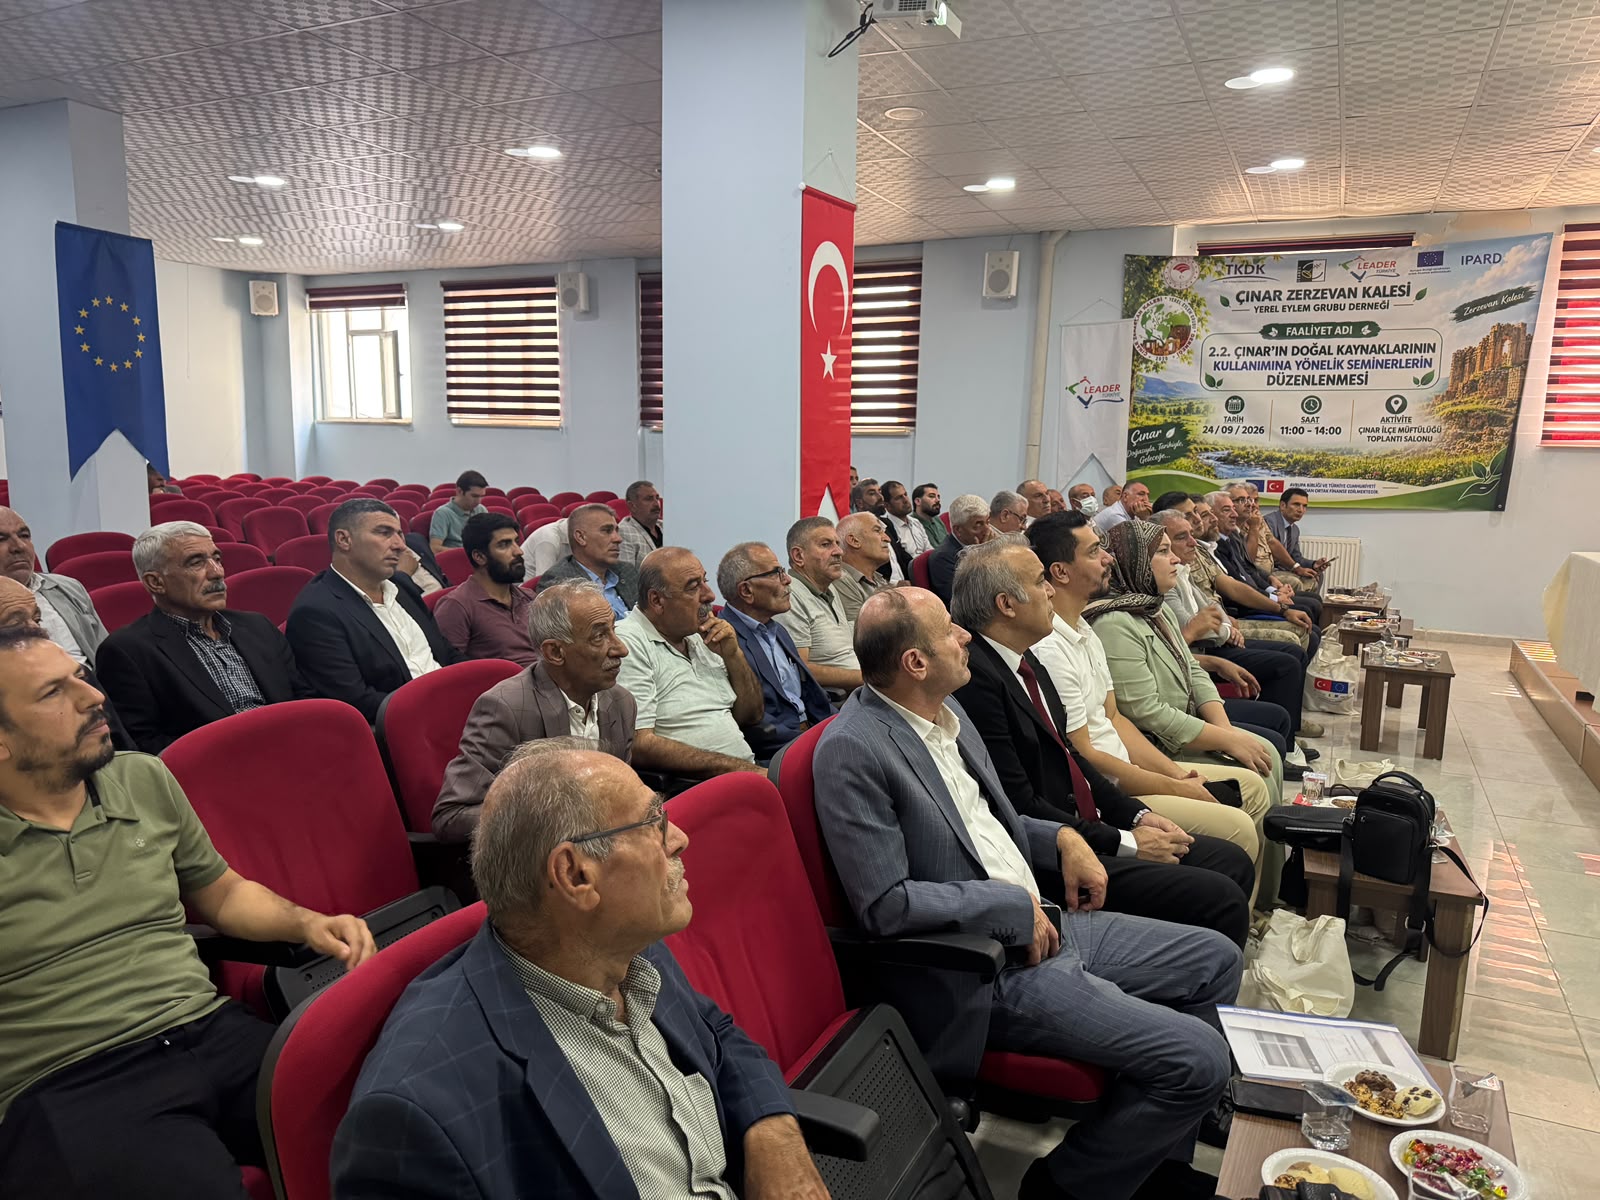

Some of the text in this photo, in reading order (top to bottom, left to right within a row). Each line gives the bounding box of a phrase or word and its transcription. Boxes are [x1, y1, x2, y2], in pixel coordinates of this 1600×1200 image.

[1461, 253, 1502, 265] IPARD
[1225, 264, 1266, 275] TKDK
[1357, 261, 1397, 270] LEADER
[1235, 282, 1411, 305] ÇINAR ZERZEVAN KALESİ
[1254, 300, 1390, 313] YEREL EYLEM GRUBU DERNEĞİ
[1463, 291, 1525, 316] Zerzevan Kalesi
[1286, 324, 1353, 336] FAALİYET ADI
[1208, 342, 1436, 359] 2.2. ÇINAR'IN DOĞAL KAYNAKLARININ
[1213, 355, 1433, 371] KULLANIMINA YÖNELİK SEMİNERLERİN
[1266, 371, 1369, 386] DÜZENLENMESİ
[1084, 384, 1121, 394] LEADER
[1223, 415, 1244, 423] TARİH
[1380, 415, 1413, 423] AKTİVİTE
[1202, 426, 1265, 434] 24 / 09 / 2026
[1280, 426, 1305, 435] 11:00
[1314, 426, 1342, 435] 14:00
[1358, 426, 1442, 435] ÇINAR İLÇE MÜFTÜLÜĞÜ
[1131, 430, 1162, 447] Çınar
